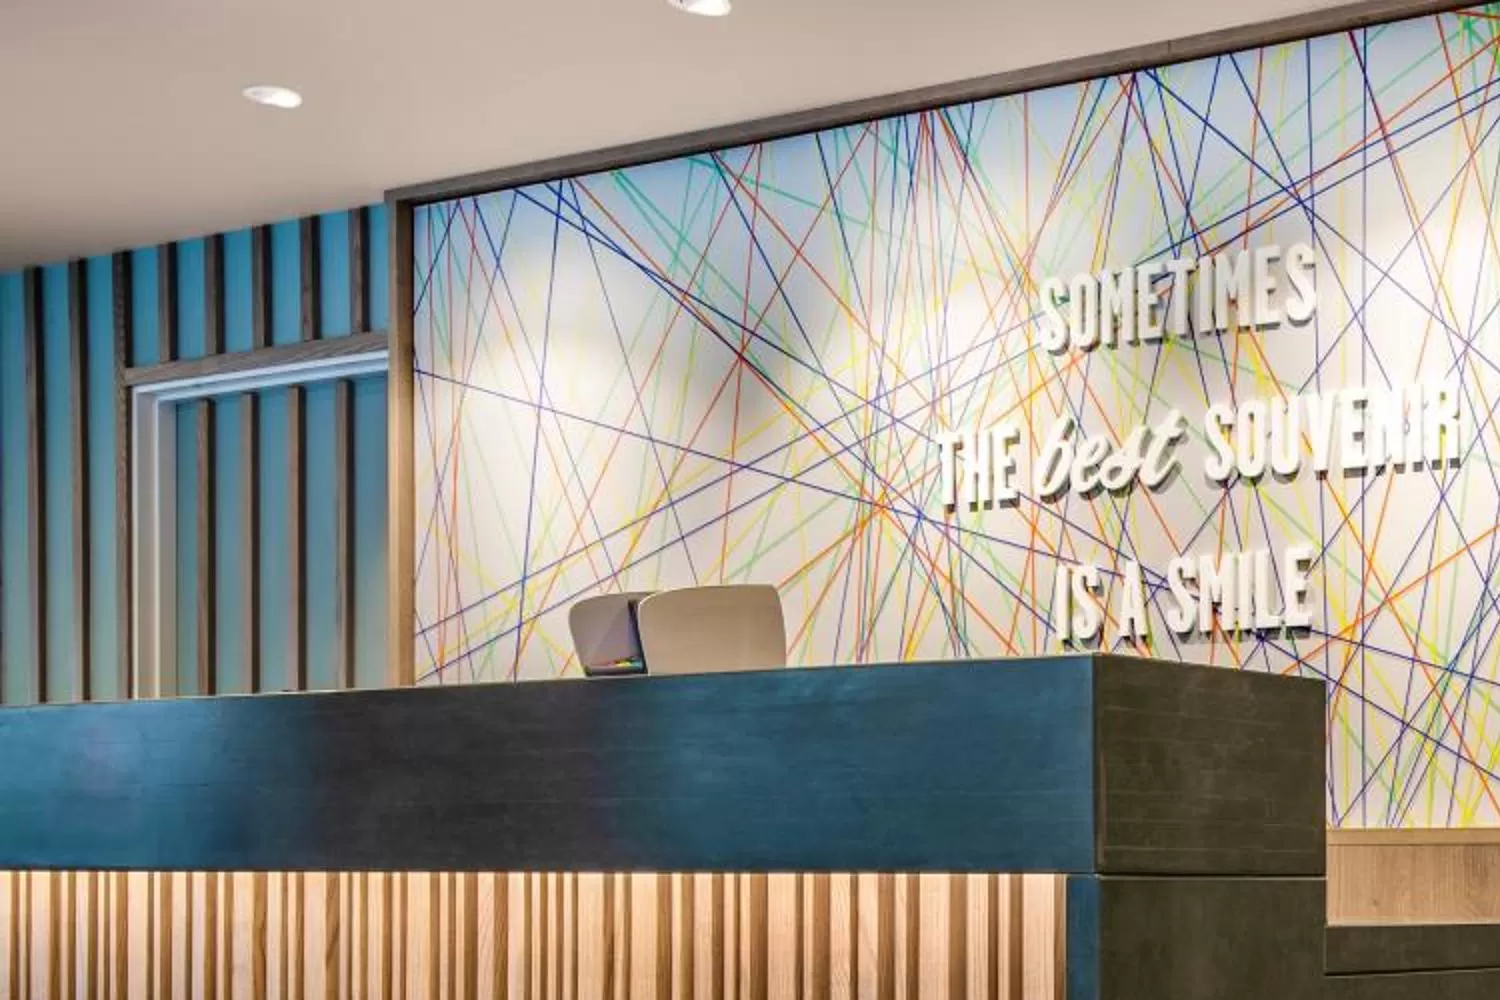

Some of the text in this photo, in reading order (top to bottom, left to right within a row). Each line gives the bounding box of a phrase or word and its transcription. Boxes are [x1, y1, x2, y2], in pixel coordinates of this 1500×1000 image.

[1039, 242, 1317, 355] SOMETIMES
[936, 376, 1463, 512] THE best SOUVENIR
[1055, 543, 1314, 643] IS A SMILE
